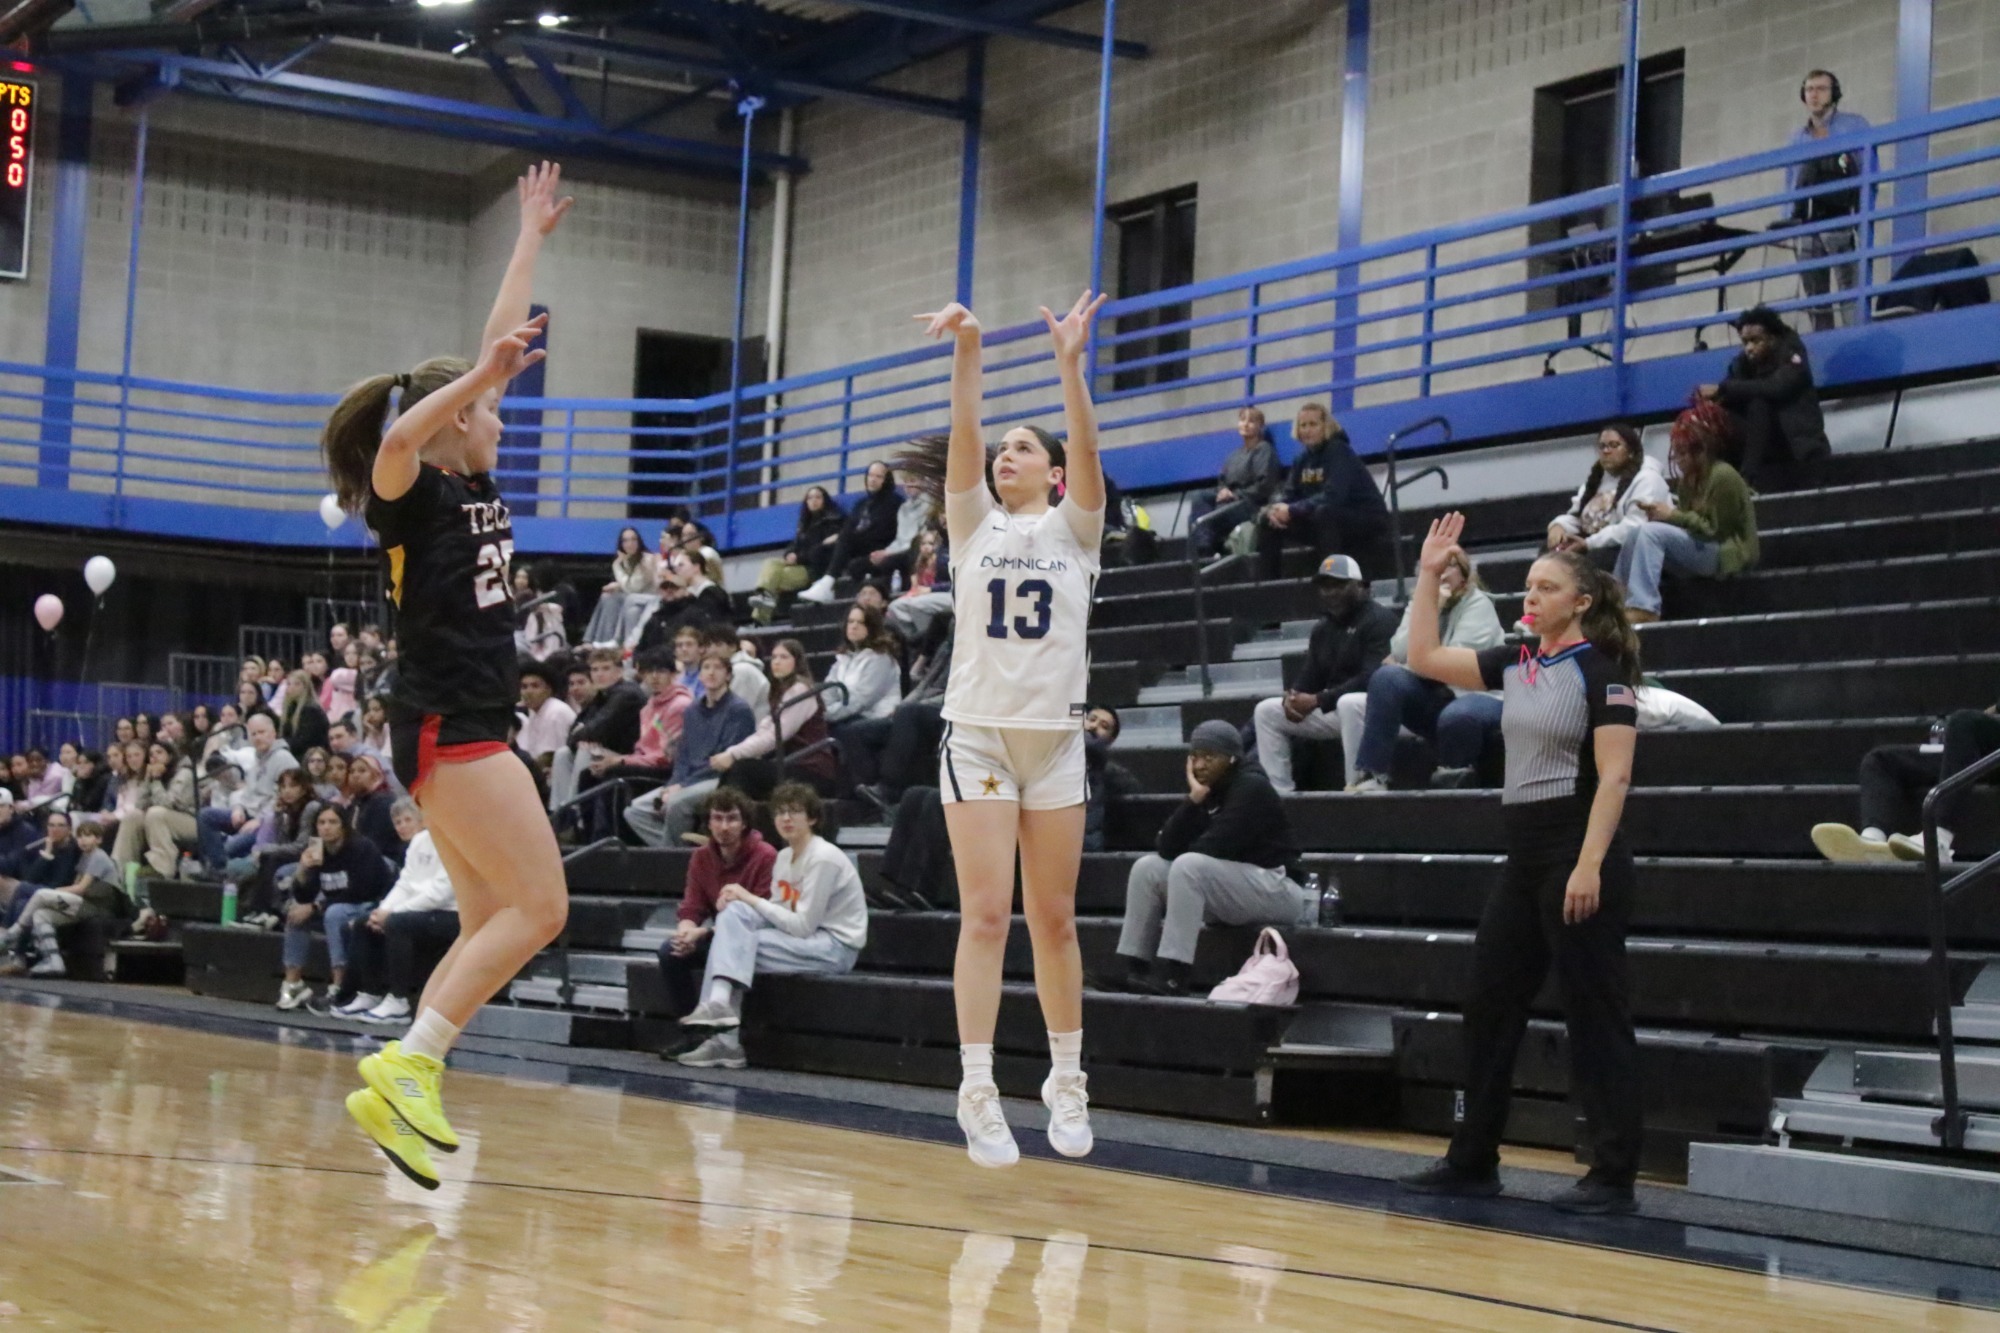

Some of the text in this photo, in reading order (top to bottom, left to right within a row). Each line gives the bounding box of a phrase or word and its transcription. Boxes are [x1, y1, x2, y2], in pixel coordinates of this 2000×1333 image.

[11, 108, 27, 132] 0
[10, 135, 25, 159] 5
[8, 163, 22, 186] 0
[461, 500, 512, 534] TEC
[980, 555, 1067, 571] DOMINICAN
[986, 578, 1053, 639] 13
